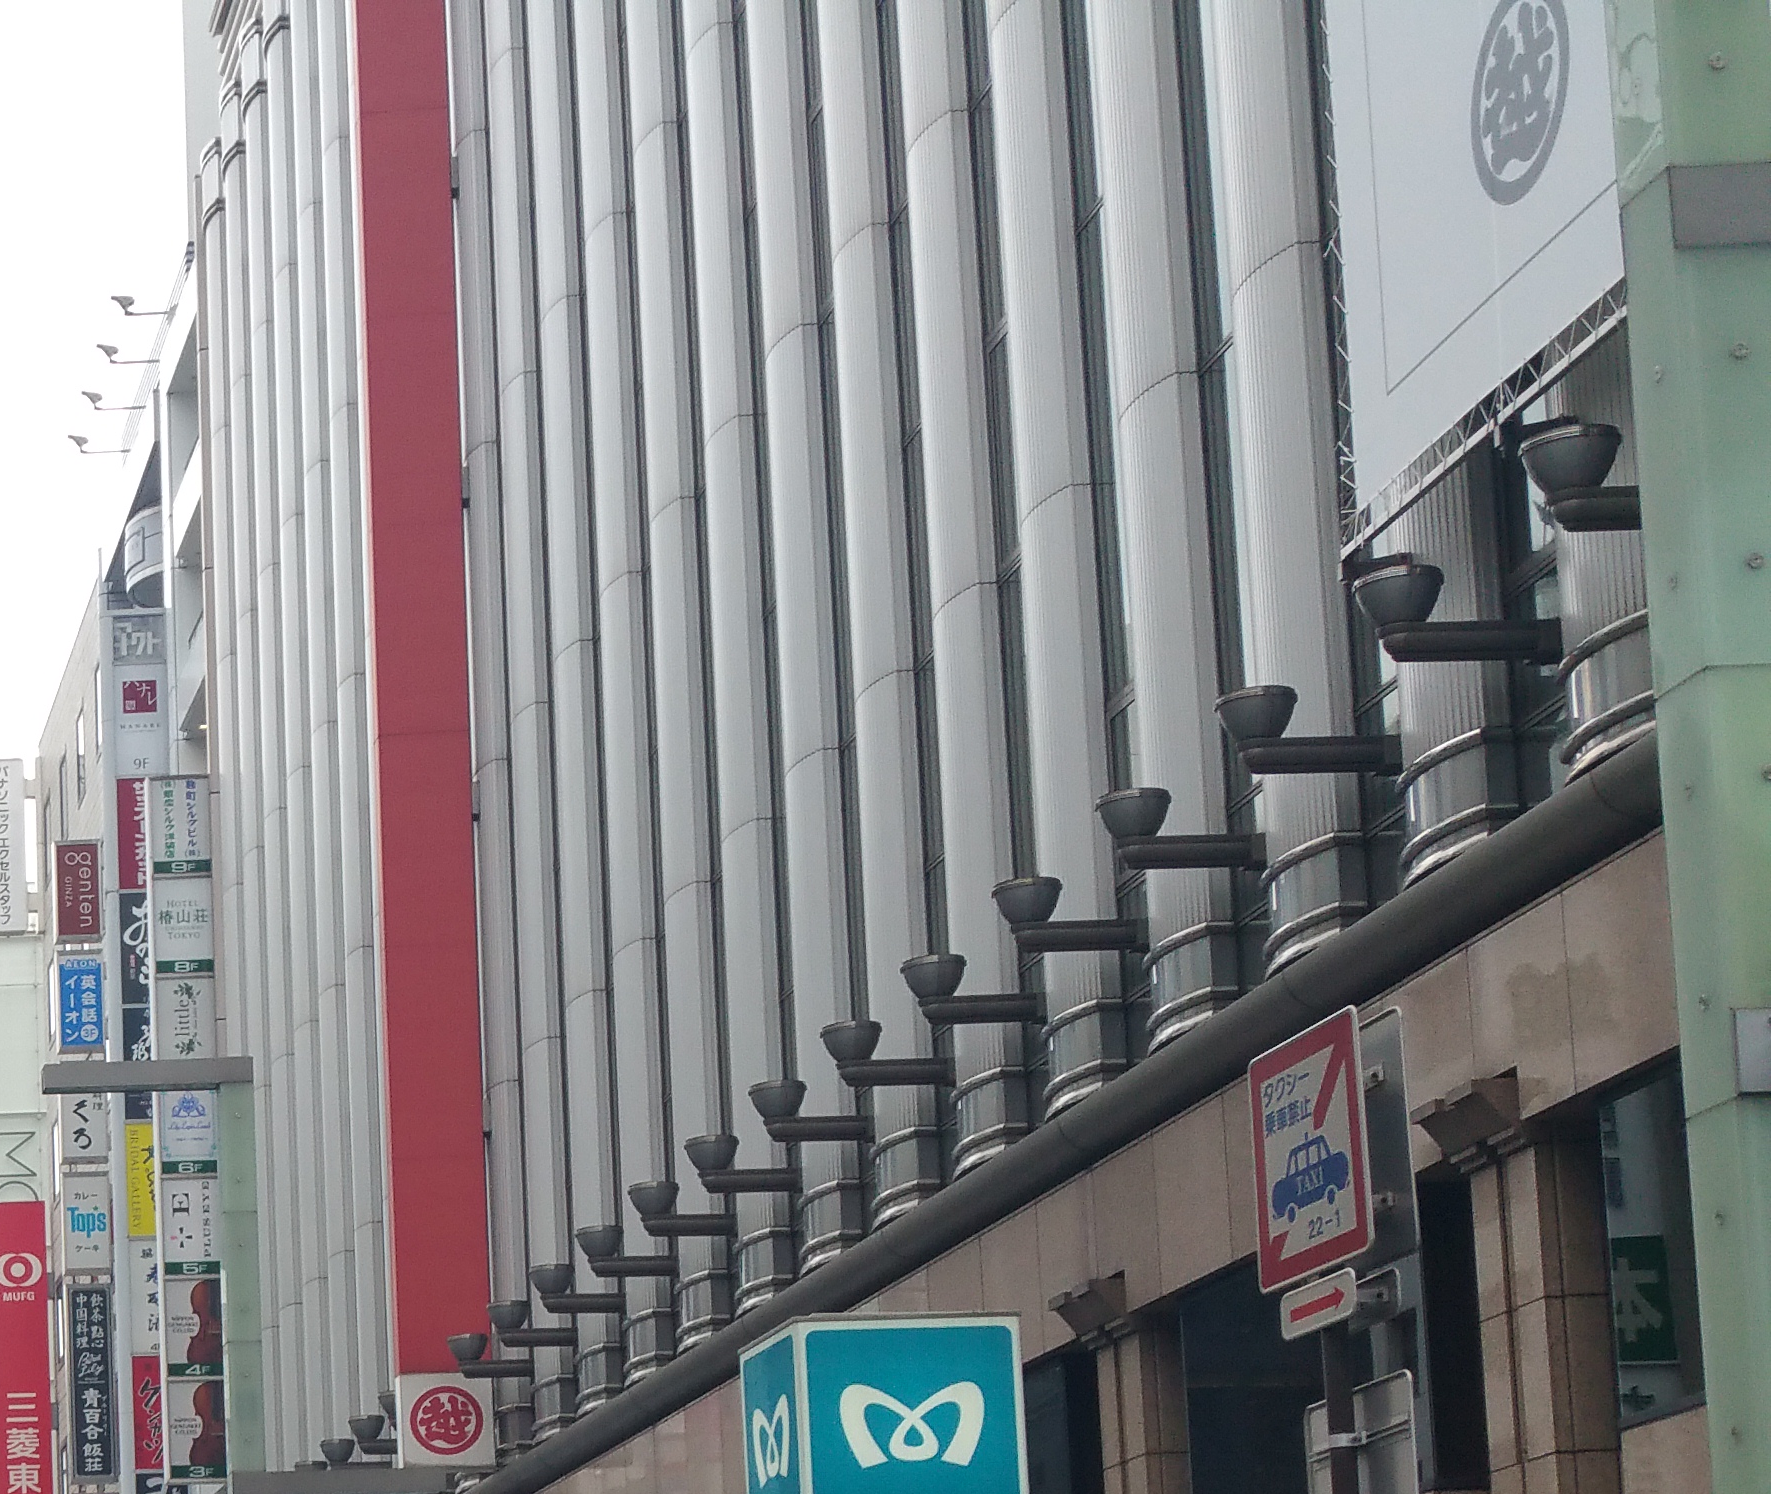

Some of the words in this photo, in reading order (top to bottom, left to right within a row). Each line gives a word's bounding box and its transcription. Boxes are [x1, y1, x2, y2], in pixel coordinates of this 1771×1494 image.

[132, 757, 151, 770] 9F
[170, 861, 197, 873] 9F
[63, 875, 74, 909] GINZA
[77, 850, 94, 929] genten
[158, 908, 209, 925] 椿山荘
[167, 931, 201, 940] TOKYO
[63, 959, 97, 969] AEON
[173, 960, 200, 973] 8F
[64, 974, 80, 1041] イーオン
[80, 974, 98, 1024] 英会話
[173, 999, 191, 1037] little
[1262, 1072, 1310, 1109] タクシー
[1264, 1095, 1312, 1139] 乗車禁止
[129, 1128, 140, 1173] BRIDAL
[177, 1161, 203, 1173] 6F
[1296, 1165, 1325, 1197] TAXI
[73, 1191, 99, 1201] カレー
[130, 1175, 143, 1230] GALLERY
[1308, 1209, 1341, 1240] 22-1
[182, 1262, 209, 1274] 5F
[2, 1291, 36, 1303] MUFG
[74, 1292, 91, 1350] 中国料理
[184, 1364, 212, 1375] 4F
[80, 1387, 105, 1473] 青百合飯荘
[188, 1465, 214, 1477] 3F
